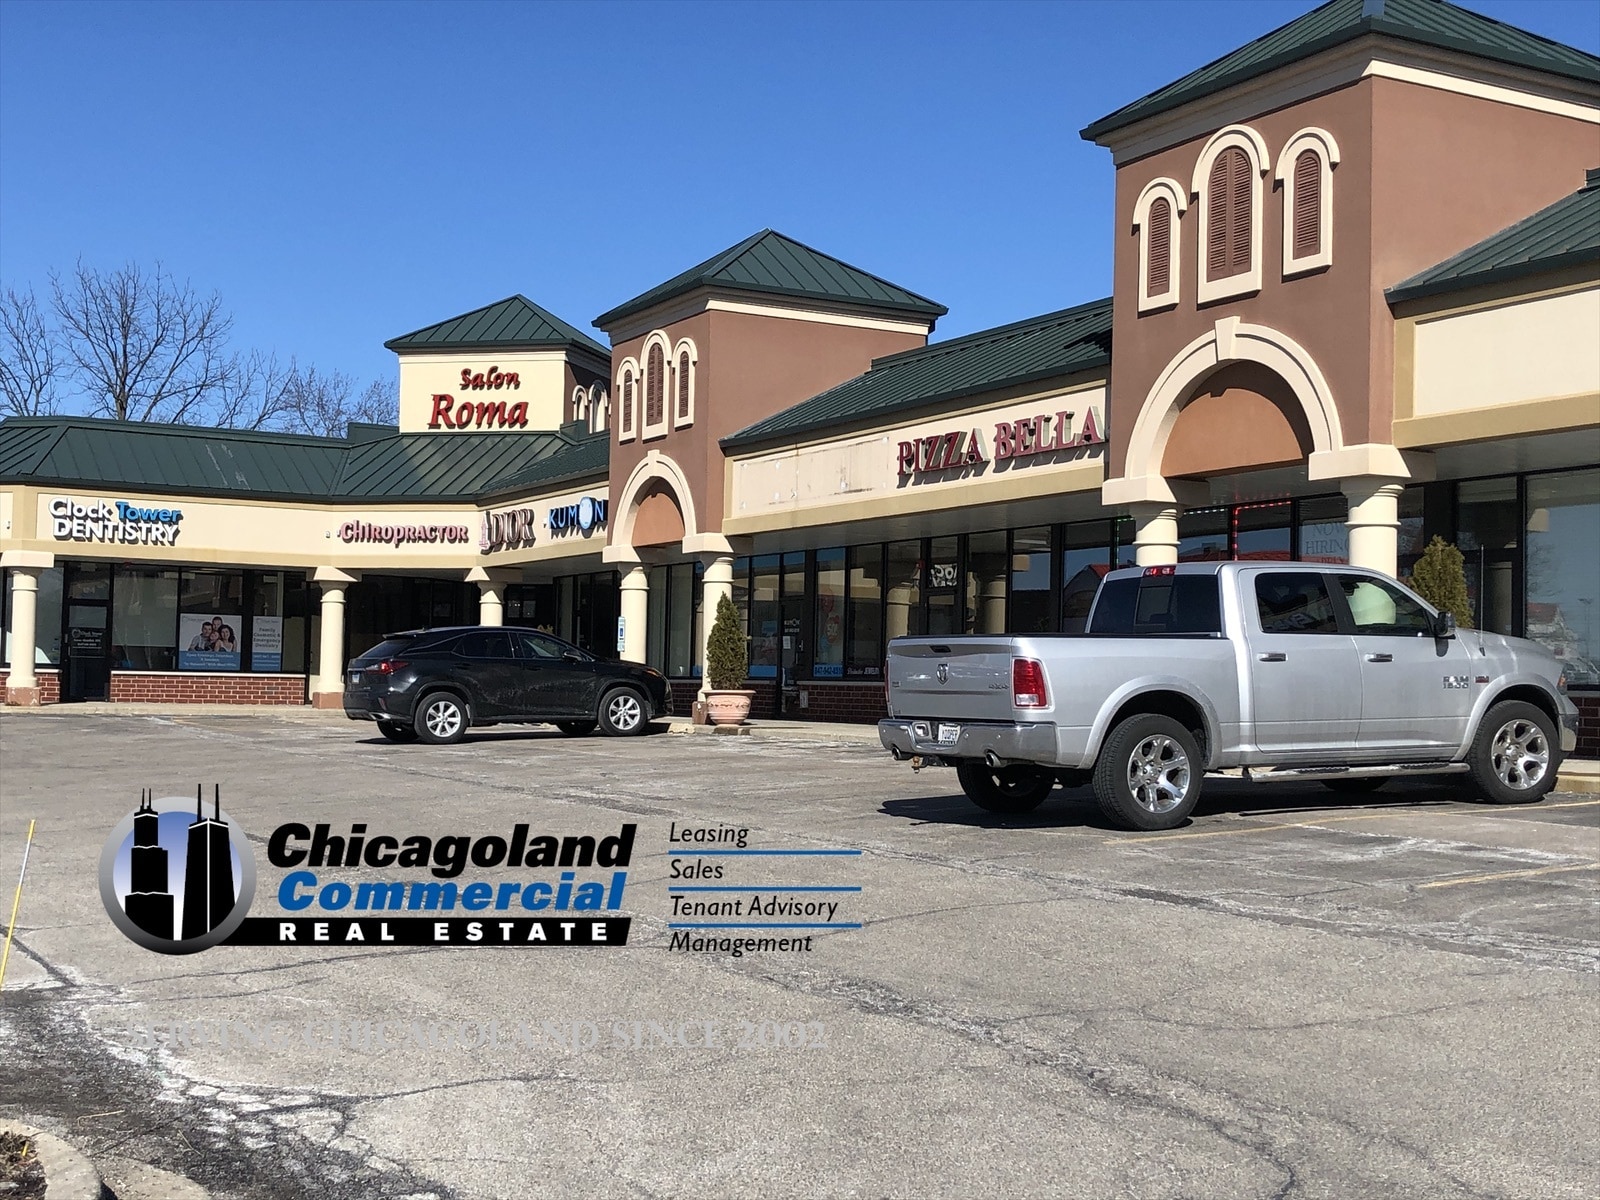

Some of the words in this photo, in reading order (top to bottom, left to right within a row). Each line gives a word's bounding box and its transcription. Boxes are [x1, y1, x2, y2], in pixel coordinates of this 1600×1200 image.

[461, 366, 520, 389] Salon
[428, 394, 528, 429] Roma
[897, 428, 990, 474] PIZZA
[994, 405, 1105, 460] BELLA
[49, 498, 112, 520] Clock
[115, 501, 182, 523] Tower
[548, 497, 607, 530] KUMON
[52, 520, 181, 545] DENTISTRY
